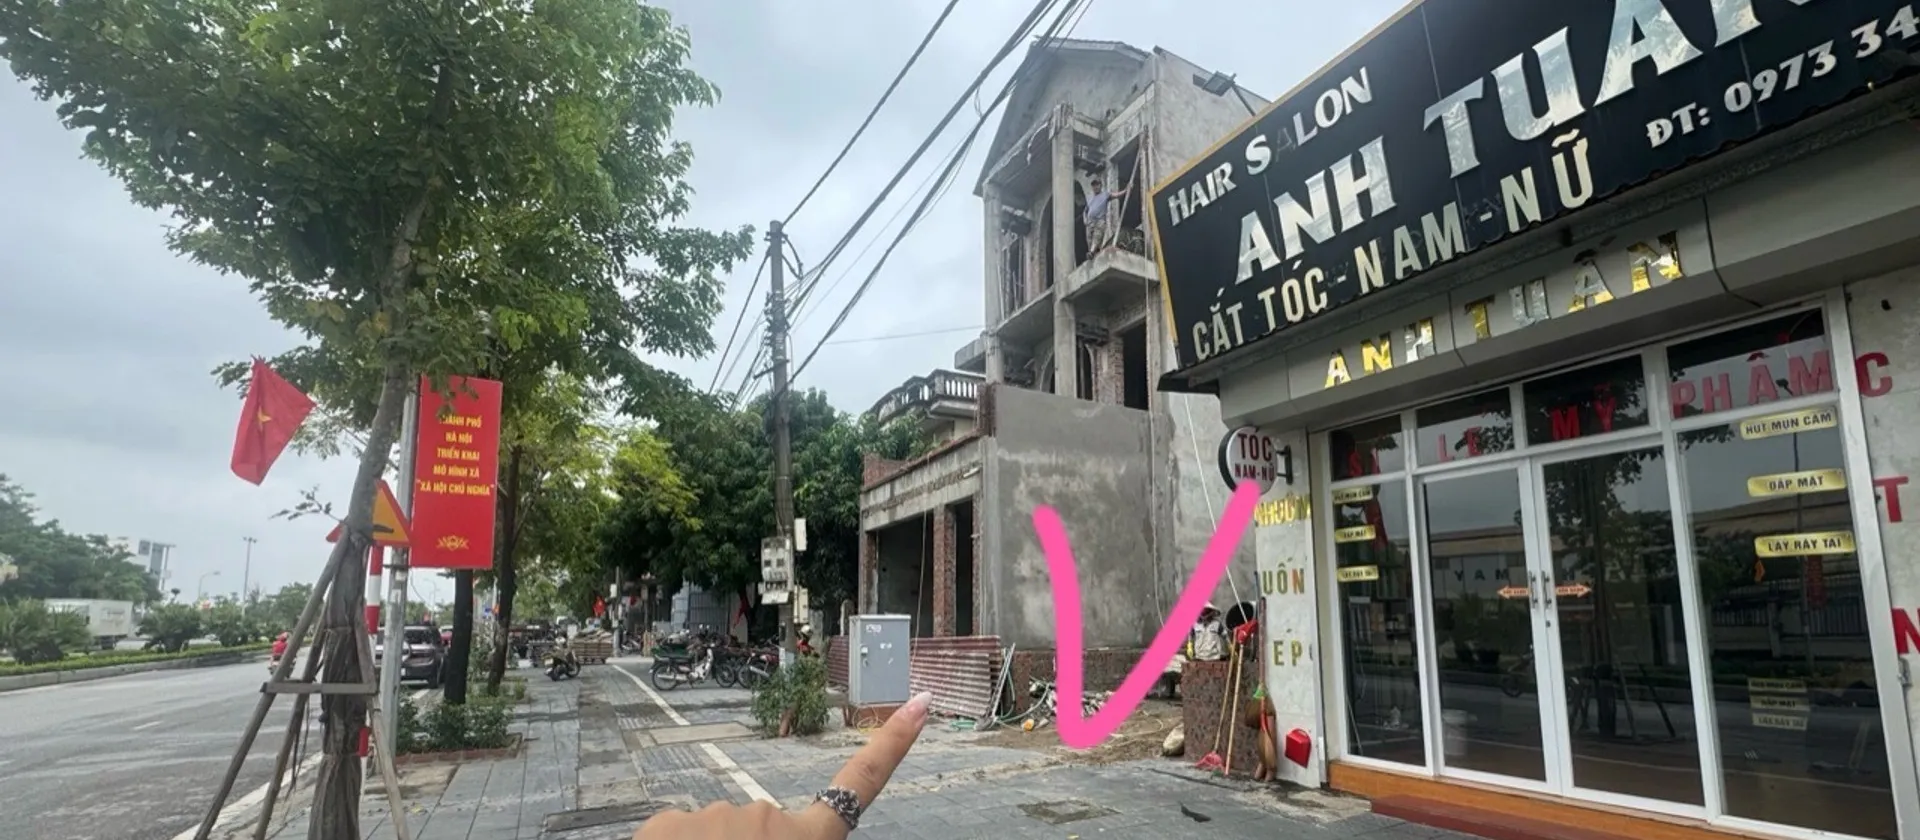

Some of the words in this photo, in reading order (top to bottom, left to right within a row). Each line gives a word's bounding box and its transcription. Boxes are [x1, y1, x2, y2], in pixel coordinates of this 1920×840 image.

[1724, 40, 1838, 113] 0973
[1168, 162, 1237, 227] HAIR
[1235, 135, 1397, 285] ANH
[1192, 287, 1243, 360] CẮT
[1324, 316, 1436, 390] ANH
[461, 449, 480, 461] KHAI
